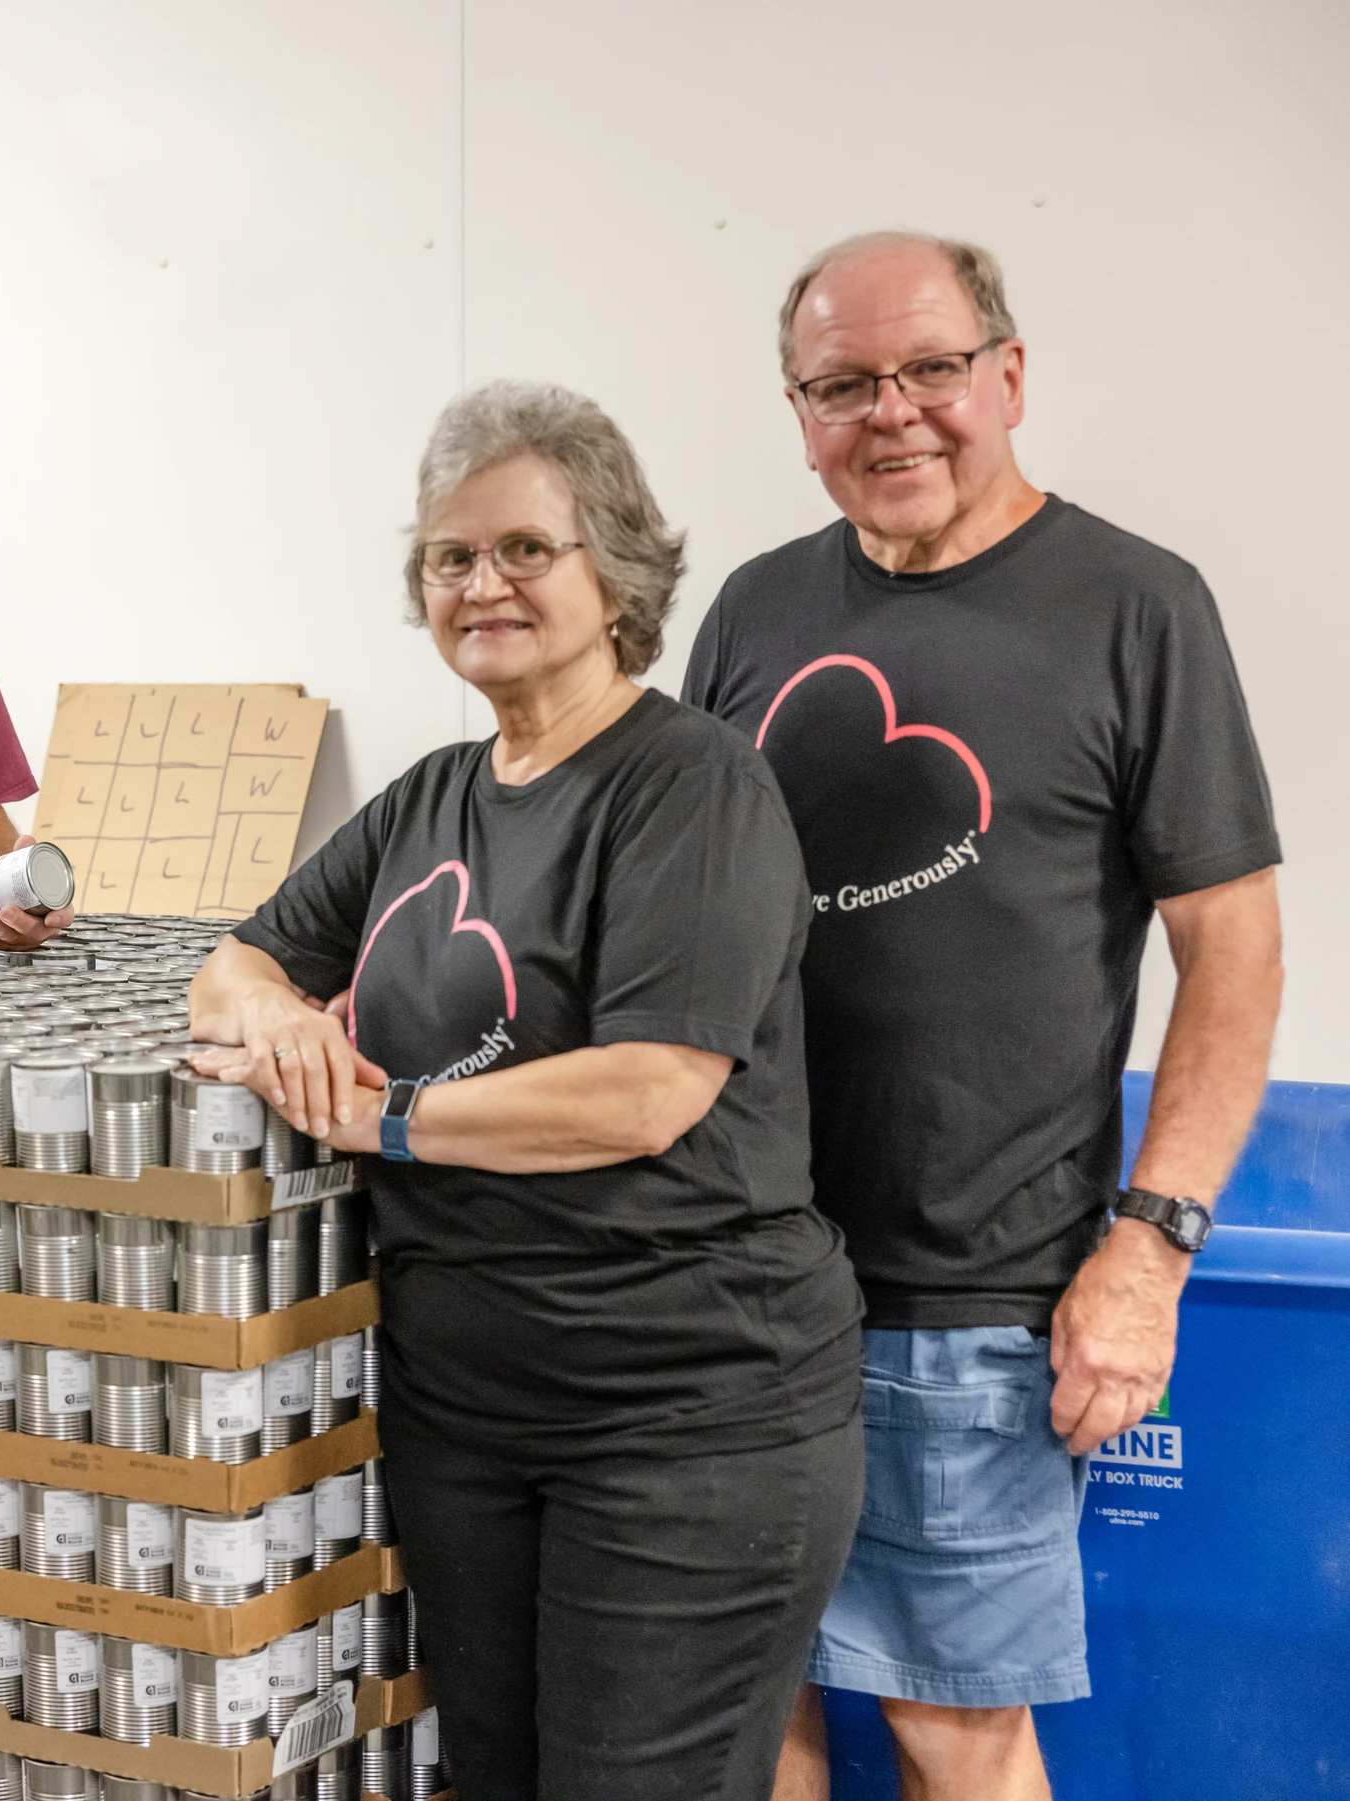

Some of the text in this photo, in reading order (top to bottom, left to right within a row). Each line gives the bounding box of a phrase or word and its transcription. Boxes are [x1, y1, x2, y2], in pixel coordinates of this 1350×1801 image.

[94, 712, 289, 741] L L L W
[77, 768, 282, 812] L L L W
[100, 836, 272, 889] L L L
[1100, 1430, 1174, 1460] LINE
[1105, 1471, 1136, 1485] BOX
[1138, 1473, 1184, 1490] TRUCK
